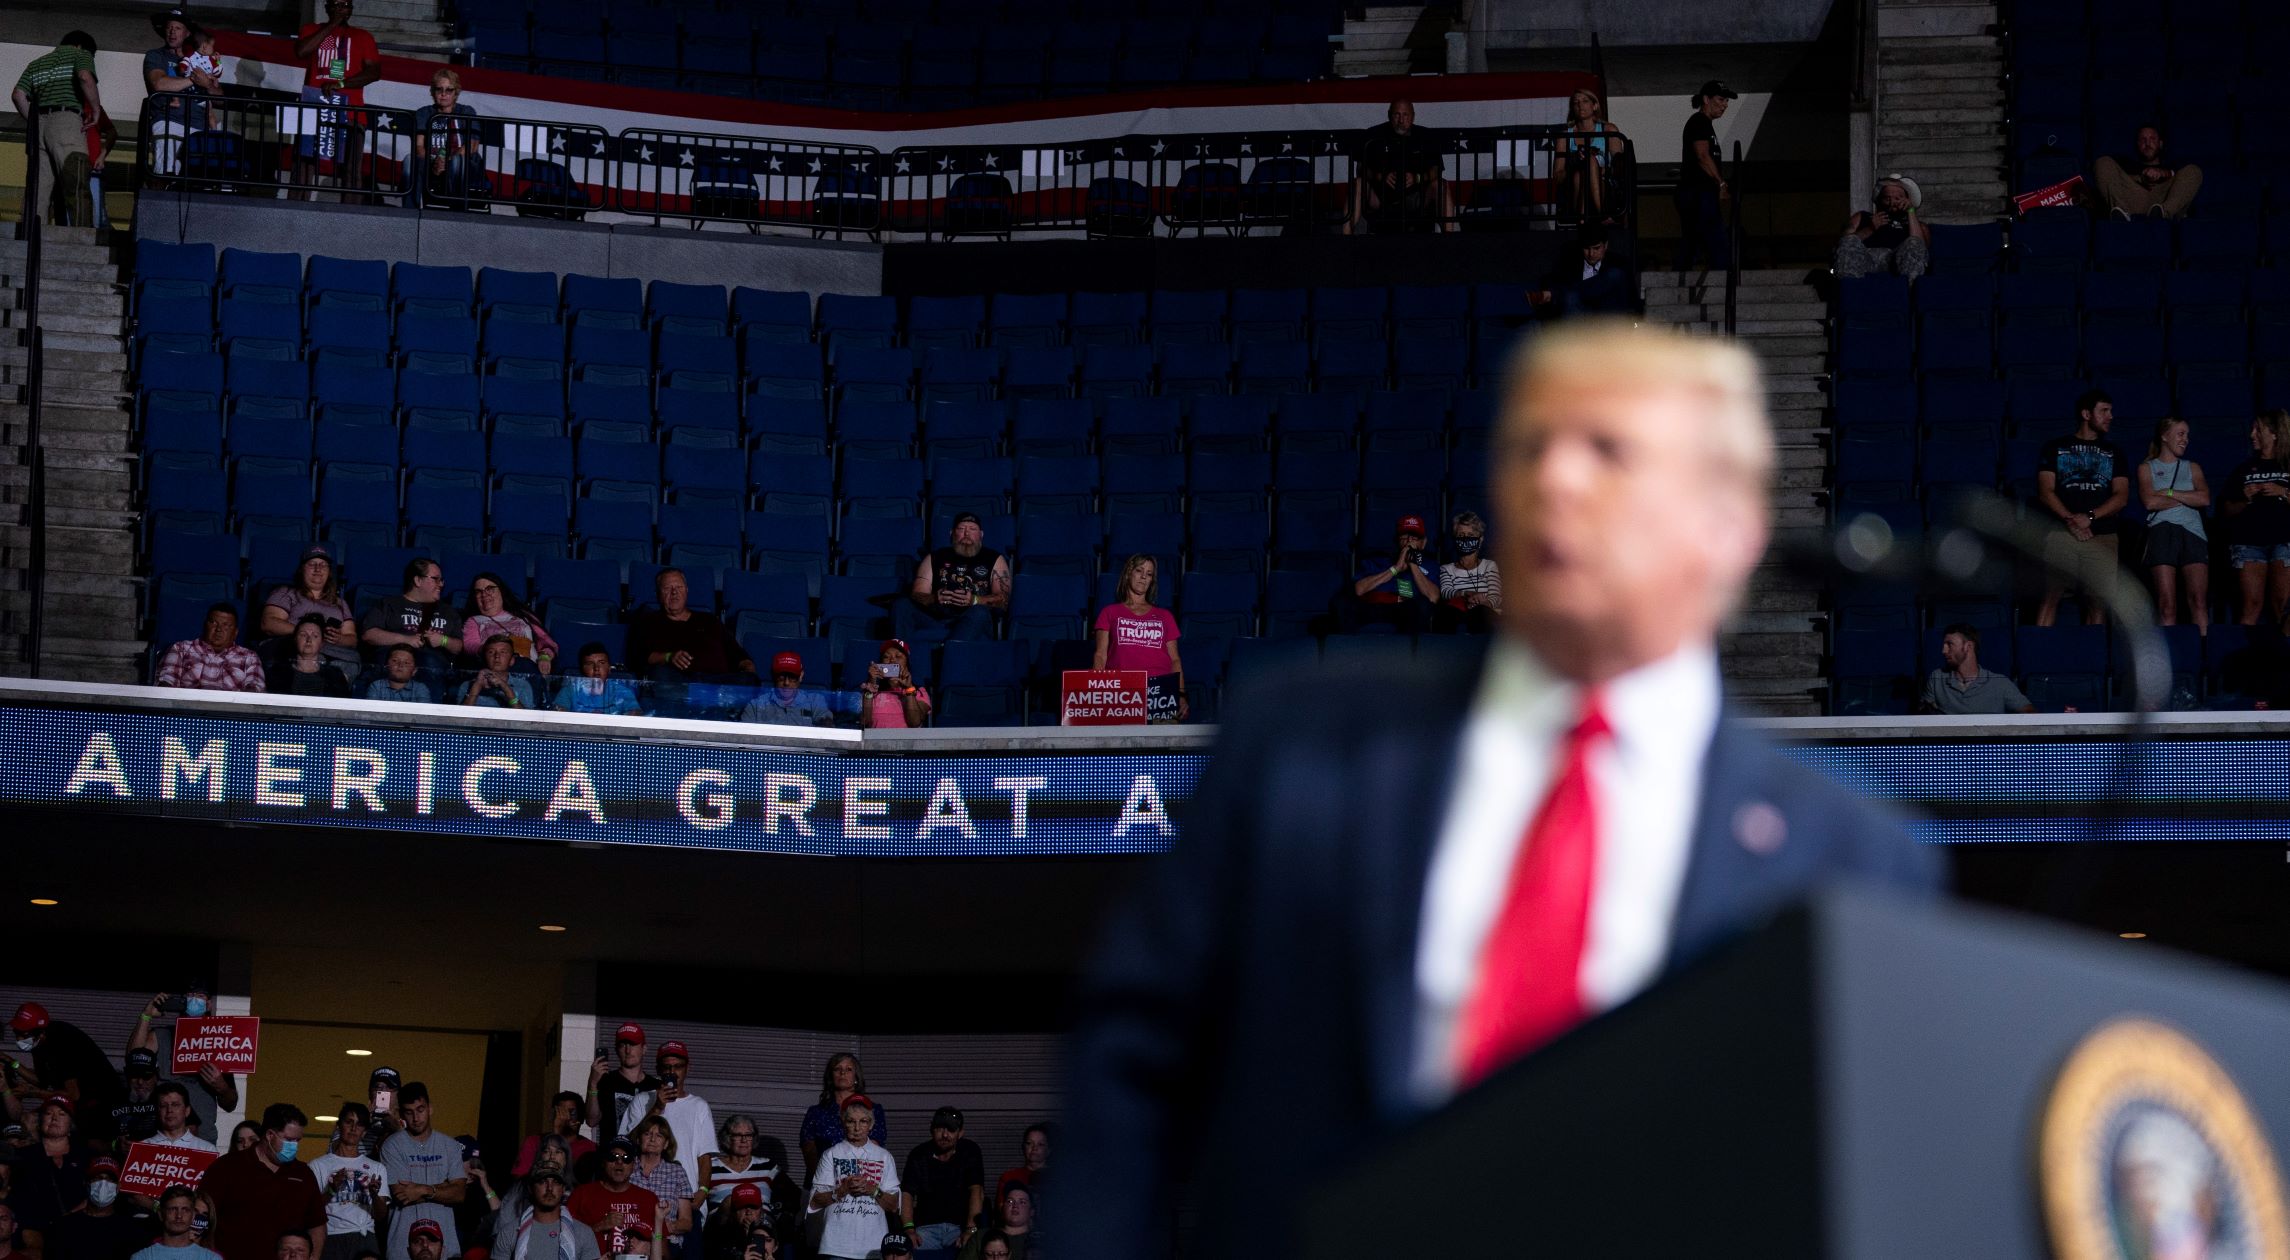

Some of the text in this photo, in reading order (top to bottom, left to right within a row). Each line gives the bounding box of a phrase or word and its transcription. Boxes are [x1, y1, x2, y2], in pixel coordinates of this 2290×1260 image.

[2040, 191, 2067, 207] MAKE
[1119, 627, 1162, 640] TRUMP
[1088, 680, 1121, 689] MAKE
[1067, 691, 1143, 705] AMERICA
[1066, 708, 1143, 717] GREAT AGAIN
[63, 731, 608, 825] AMERICA
[676, 768, 1048, 839] GREAT
[200, 1025, 233, 1034] MAKE
[178, 1036, 253, 1050] AMERICA
[177, 1052, 253, 1063] GREAT AGAIN
[154, 1153, 190, 1165] MAKE
[127, 1161, 205, 1181] AMERICA
[124, 1174, 165, 1187] GREAT
[884, 1234, 906, 1245] USAF
